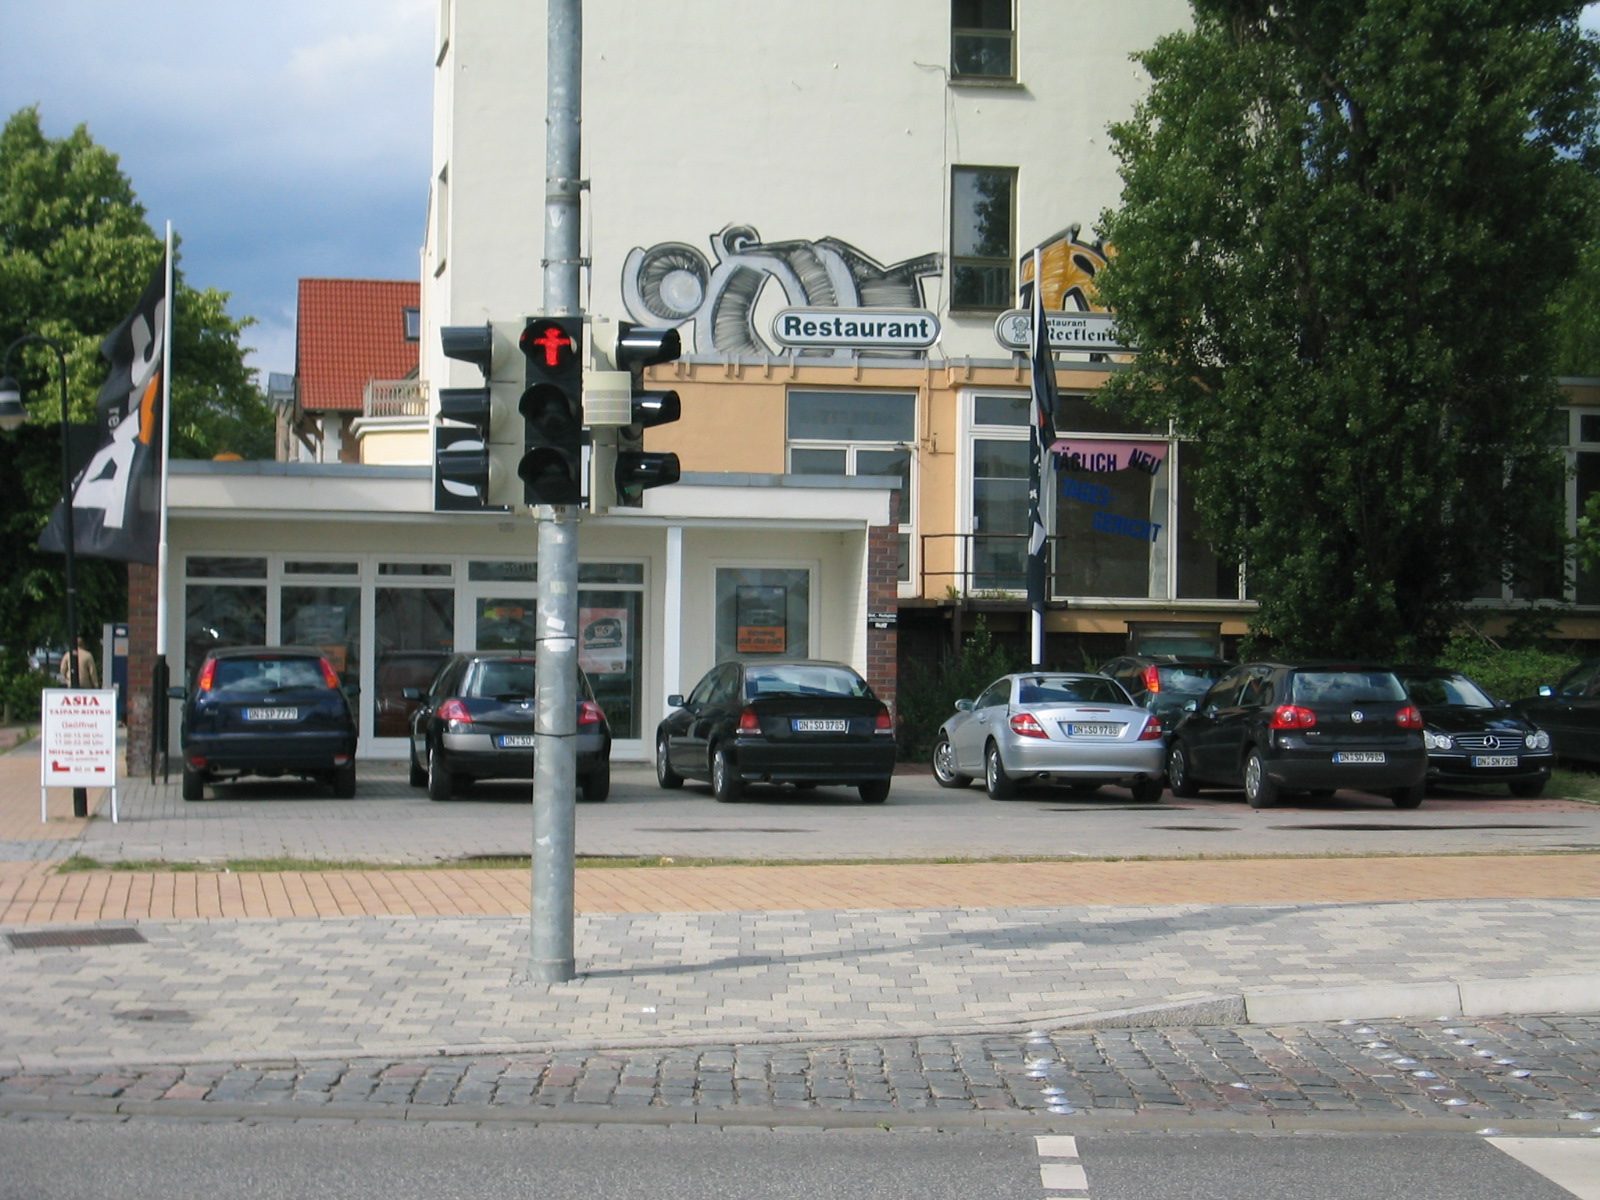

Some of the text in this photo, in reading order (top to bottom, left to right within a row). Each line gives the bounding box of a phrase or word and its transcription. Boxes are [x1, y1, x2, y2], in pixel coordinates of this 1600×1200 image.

[784, 316, 929, 338] Restaurant
[1047, 319, 1088, 328] staurant
[1052, 446, 1163, 477] TÄGLICH NEU
[61, 696, 100, 706] ASIA
